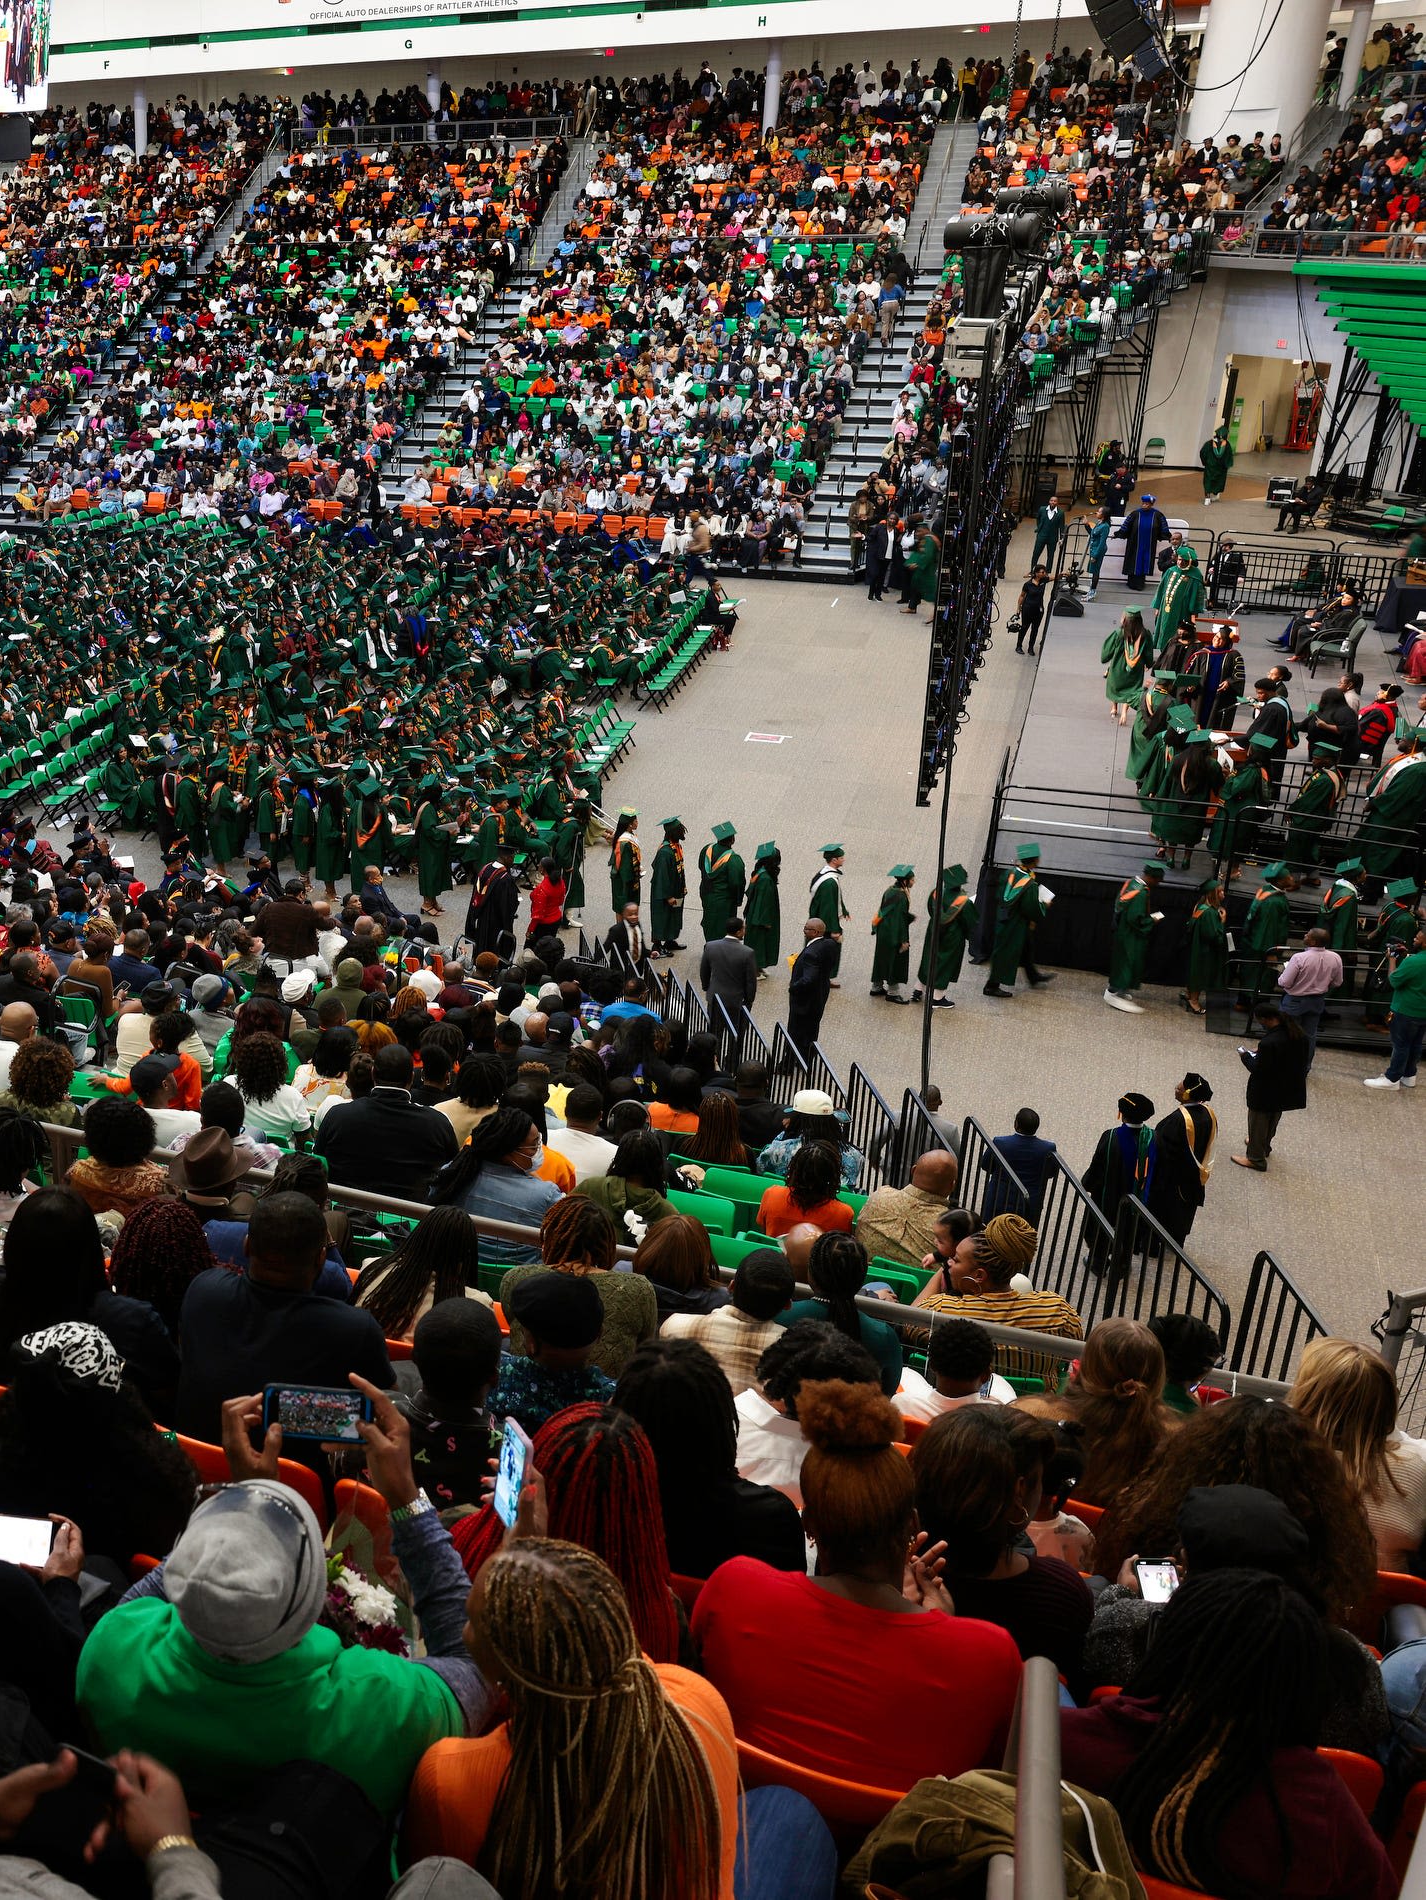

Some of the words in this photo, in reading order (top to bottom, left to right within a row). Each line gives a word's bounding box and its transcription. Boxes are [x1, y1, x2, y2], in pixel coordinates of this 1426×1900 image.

[310, 11, 343, 20] OFFICIAL
[345, 9, 366, 17] AUTO
[368, 5, 421, 15] DEALERSHIPS
[436, 2, 472, 10] RATTLER
[474, 0, 518, 8] ATHLETICS
[758, 16, 767, 26] H
[404, 40, 413, 50] G
[103, 60, 110, 70] F
